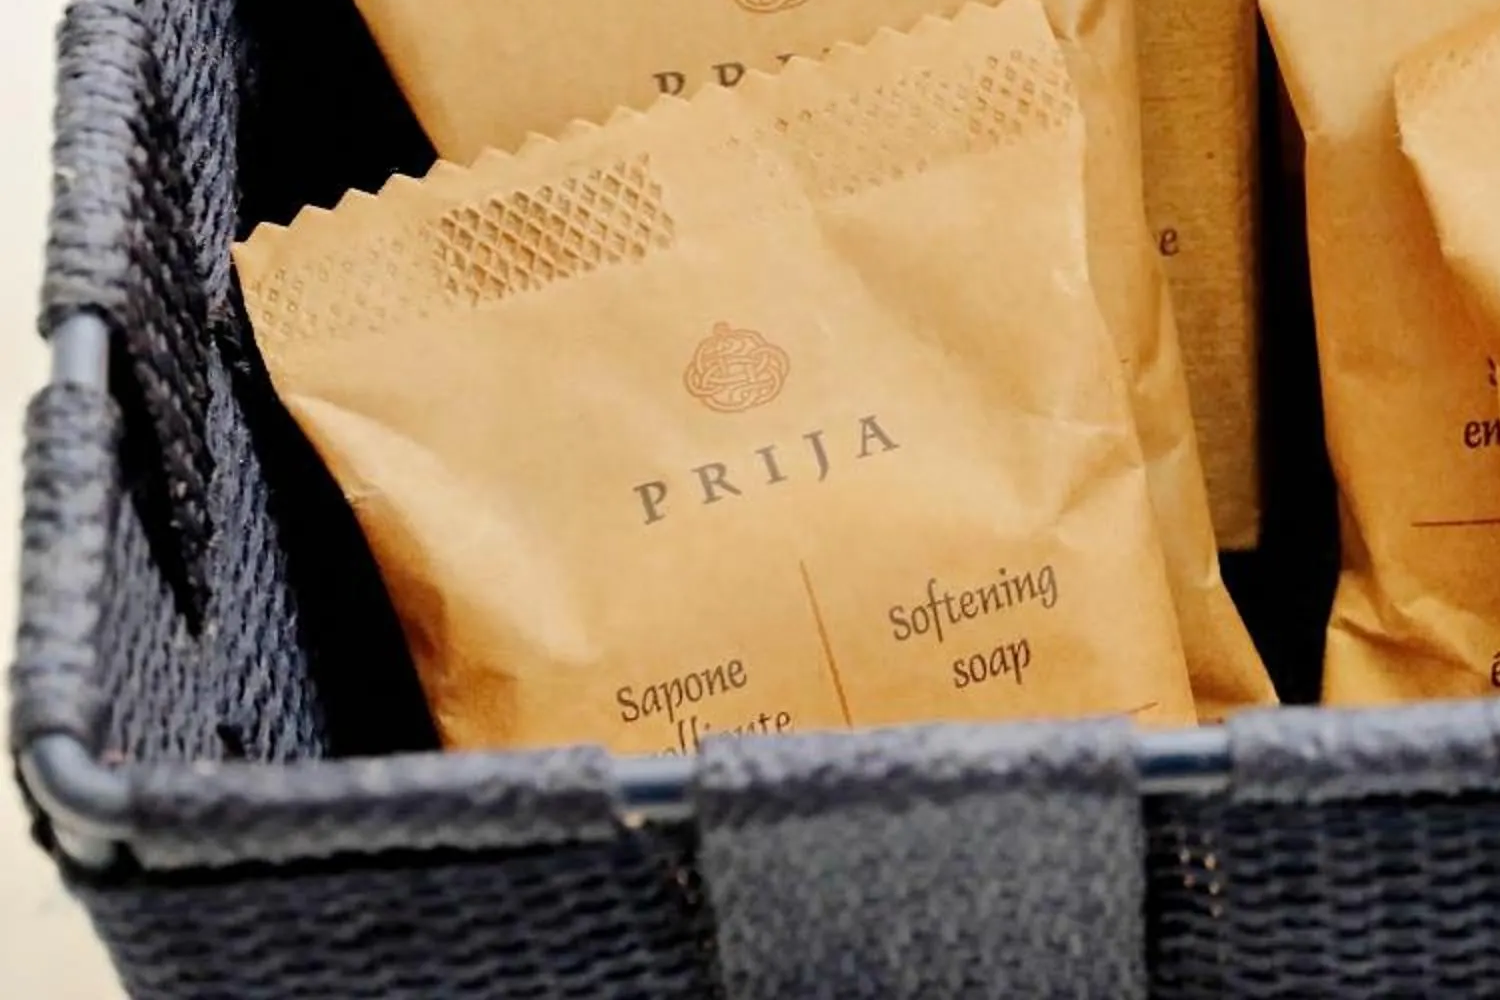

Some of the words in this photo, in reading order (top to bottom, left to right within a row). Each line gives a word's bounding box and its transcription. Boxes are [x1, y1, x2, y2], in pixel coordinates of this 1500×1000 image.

[632, 414, 901, 525] PRIJA
[888, 564, 1060, 642] Softening
[615, 655, 749, 724] Sapone
[952, 636, 1033, 690] soap
